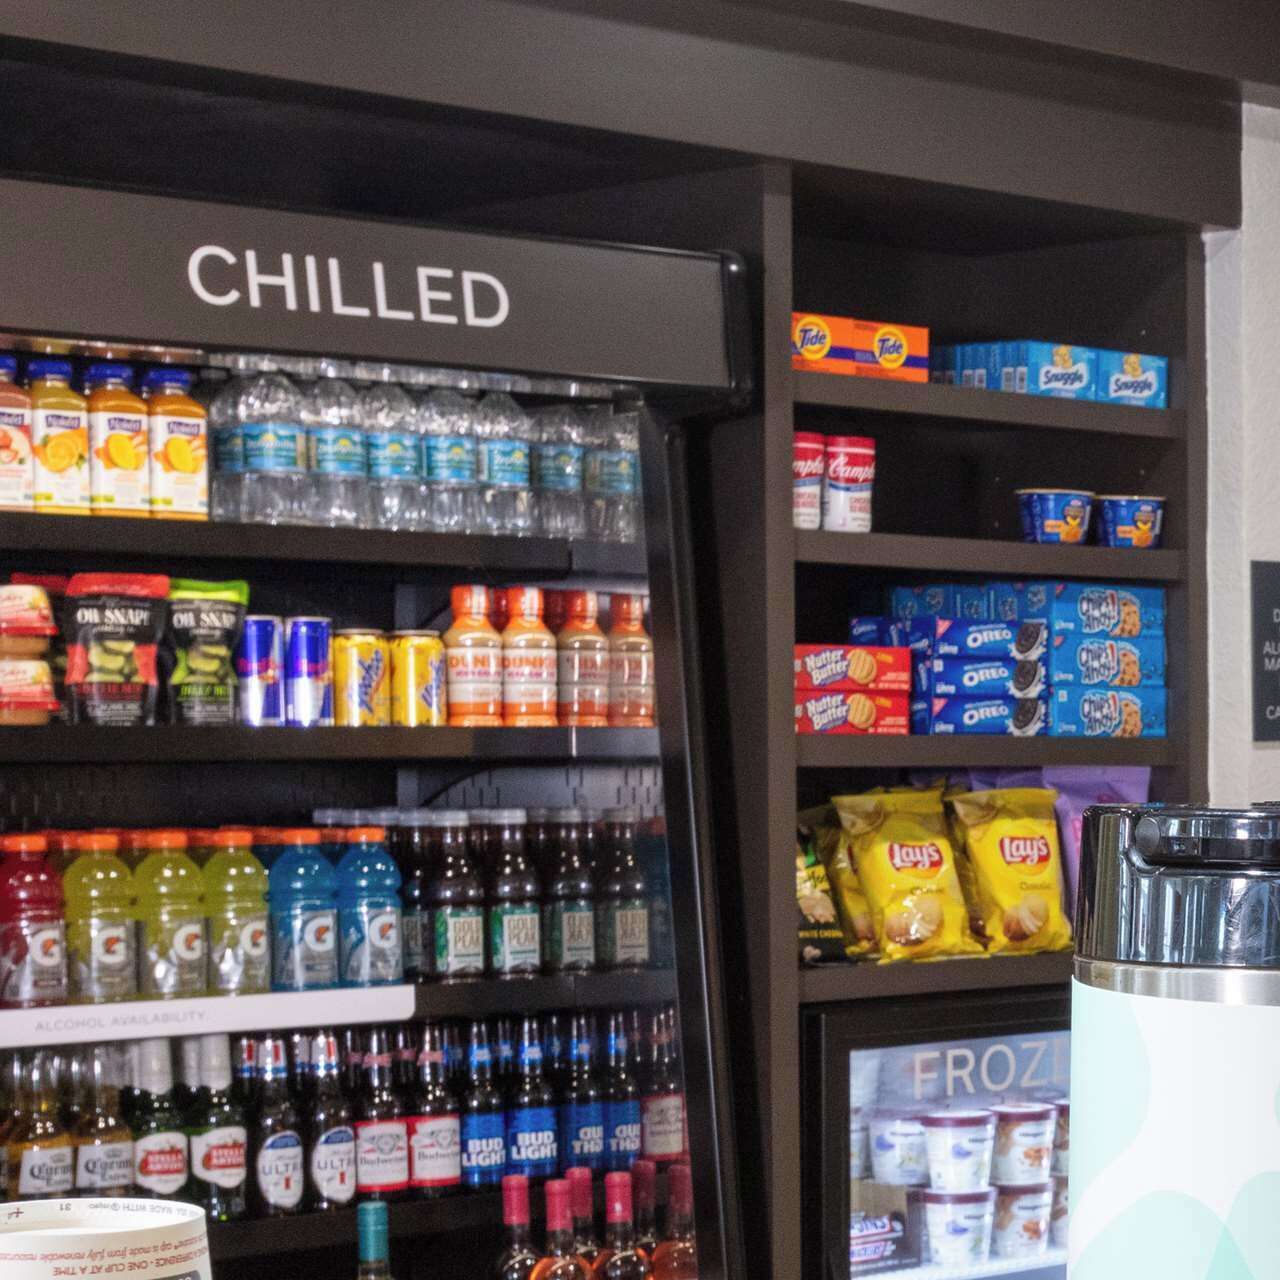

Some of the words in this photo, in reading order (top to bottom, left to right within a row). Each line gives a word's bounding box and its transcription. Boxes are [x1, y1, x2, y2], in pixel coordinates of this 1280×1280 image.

[188, 245, 511, 328] CHILLED
[799, 328, 827, 349] Tide
[878, 338, 904, 358] Tide
[966, 629, 1012, 648] OREO
[963, 667, 1009, 687] OREO
[963, 705, 1009, 725] OREO
[890, 841, 941, 870] Lay's
[1000, 836, 1049, 864] Lay's
[35, 1017, 107, 1033] ALCOHOL
[468, 1138, 504, 1154] BUD
[517, 1131, 554, 1146] BUD
[512, 1143, 557, 1159] LIGHT
[53, 1267, 77, 1276] TIME
[79, 1266, 88, 1275] A
[89, 1265, 102, 1275] AT
[105, 1263, 125, 1273] CUP
[127, 1261, 149, 1271] ONE
